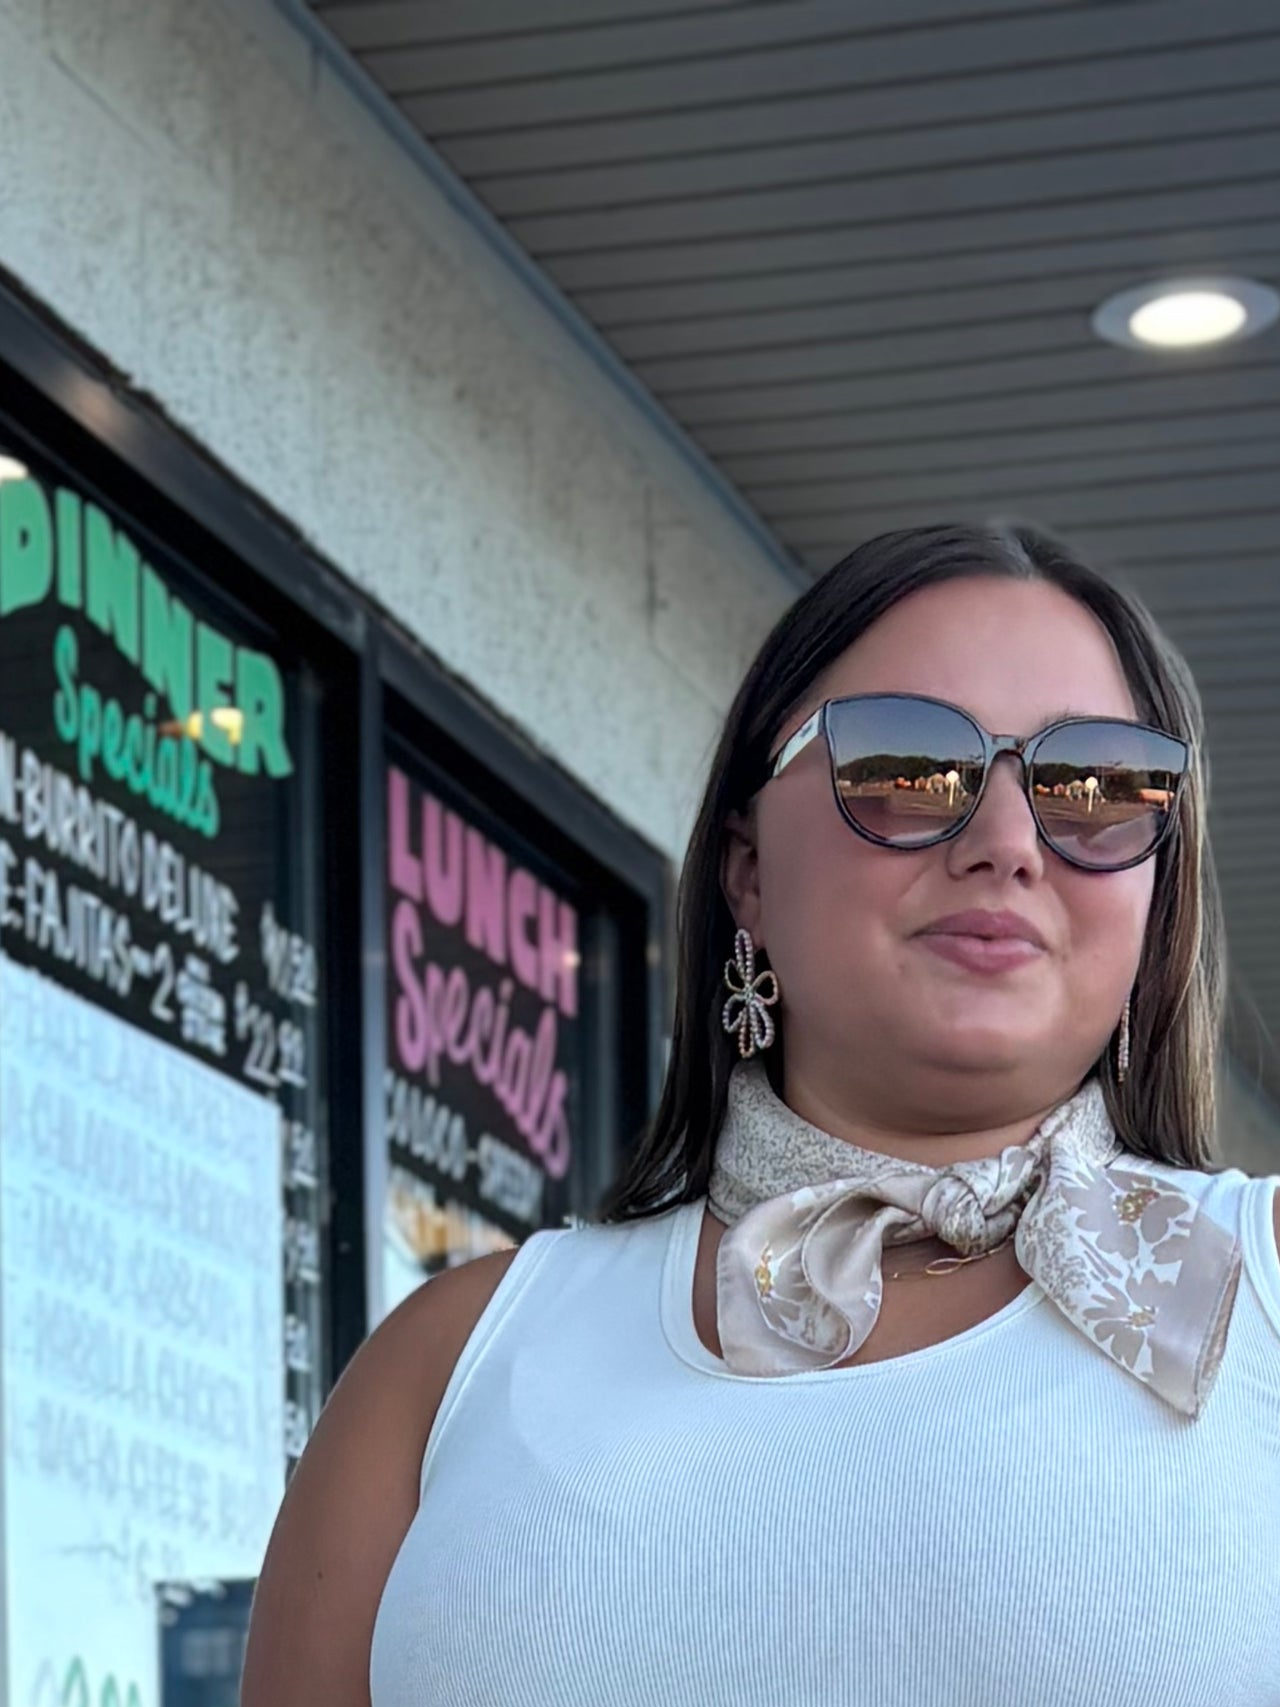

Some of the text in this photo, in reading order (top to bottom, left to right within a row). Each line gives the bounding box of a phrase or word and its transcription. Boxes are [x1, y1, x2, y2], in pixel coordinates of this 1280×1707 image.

[53, 624, 219, 838] Specials
[387, 766, 578, 1019] LUNCH
[390, 899, 570, 1179] Specials
